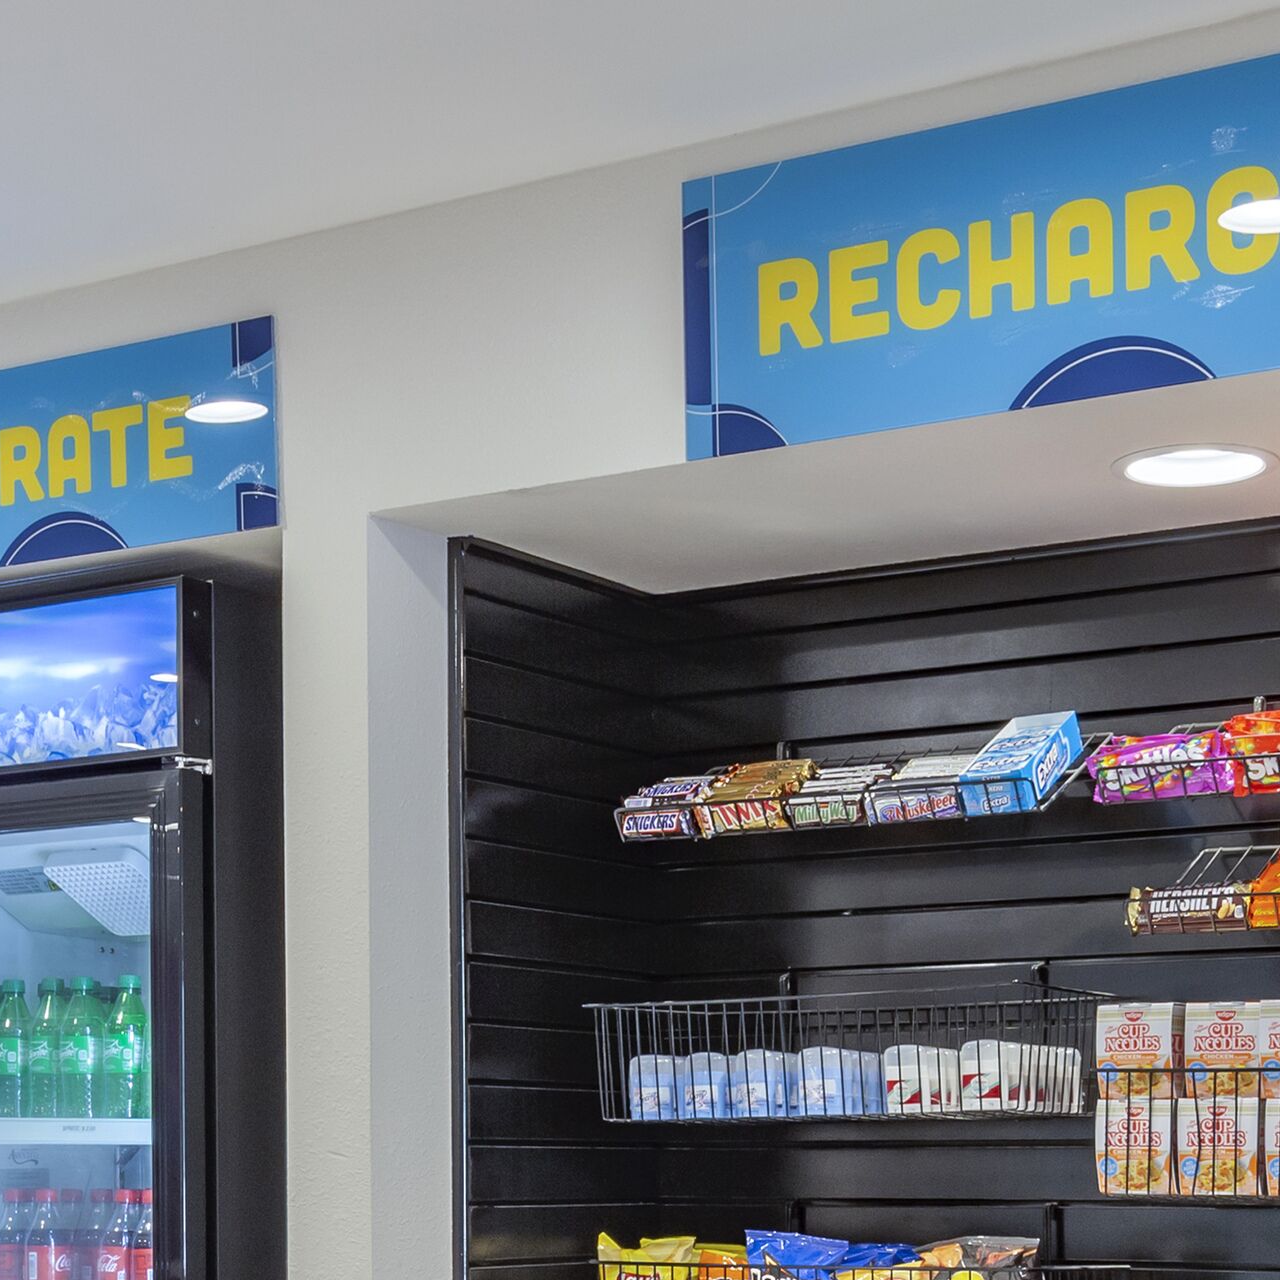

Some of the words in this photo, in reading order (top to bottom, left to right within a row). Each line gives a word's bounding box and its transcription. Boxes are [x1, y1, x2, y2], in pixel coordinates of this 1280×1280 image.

[1105, 751, 1206, 790] Skittles
[983, 797, 1009, 811] Extra
[709, 800, 776, 829] TWIX
[795, 803, 830, 825] Mily
[625, 814, 677, 832] SNICKERS
[1117, 1024, 1150, 1037] CUP
[1208, 1023, 1243, 1038] CUP
[1105, 1035, 1161, 1052] NOODLES
[1194, 1035, 1255, 1052] NOODLES
[1117, 1119, 1150, 1133] CUP
[1200, 1118, 1235, 1133] CUP
